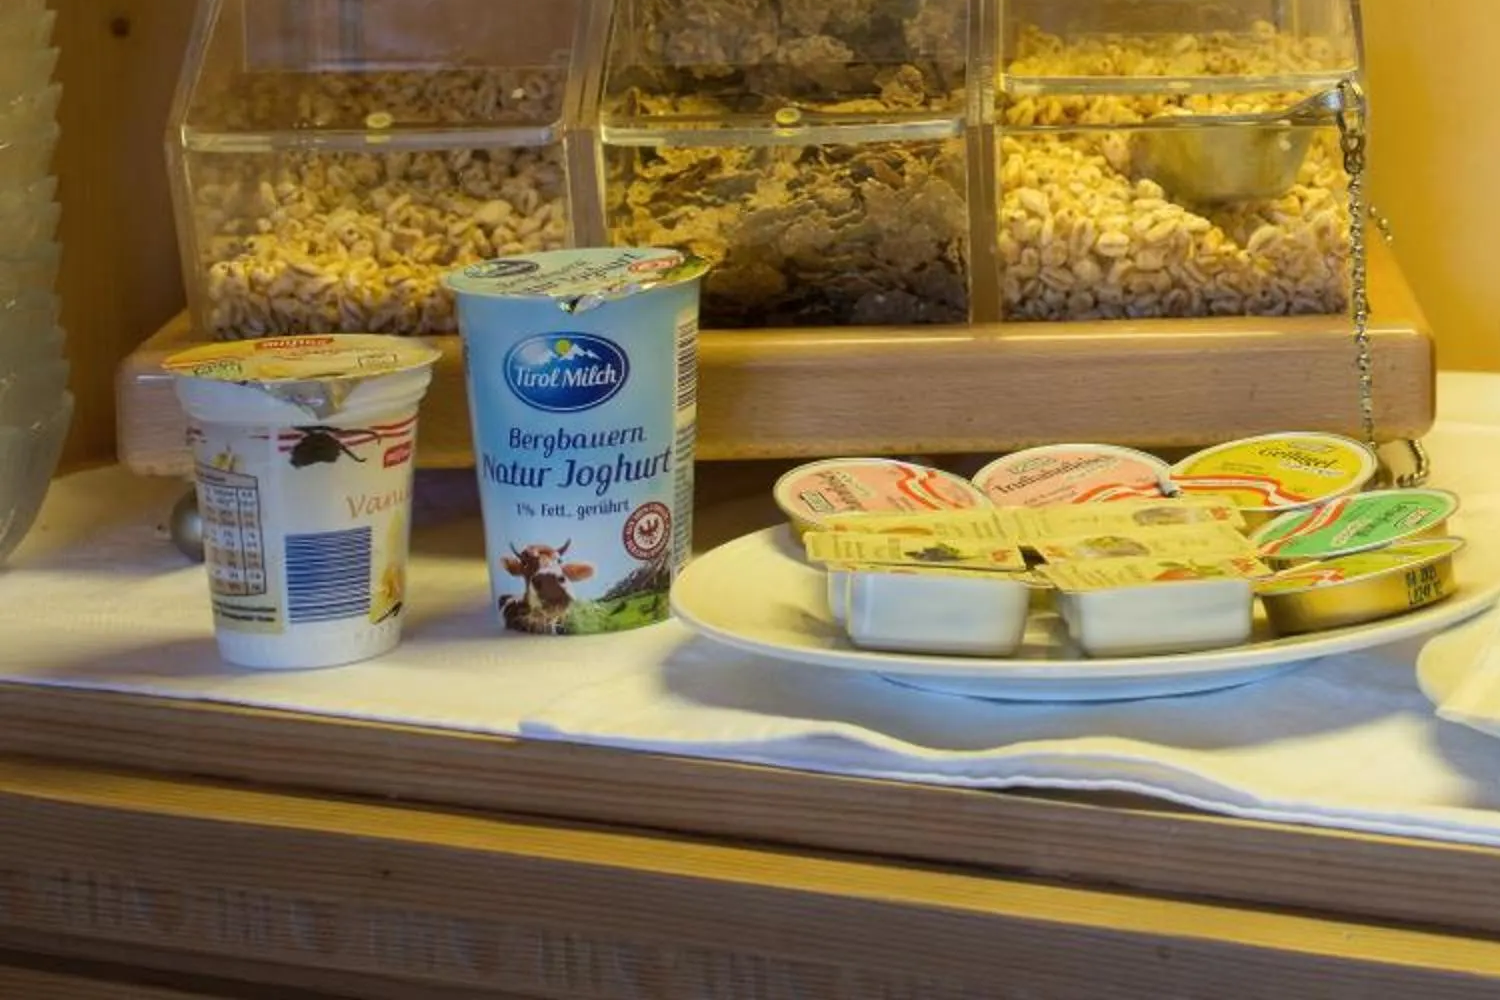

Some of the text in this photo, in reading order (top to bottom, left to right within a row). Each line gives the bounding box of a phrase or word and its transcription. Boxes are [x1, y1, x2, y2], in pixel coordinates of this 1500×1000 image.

[515, 363, 617, 387] Tirol Milch
[509, 426, 645, 458] Bergbauern
[483, 446, 672, 496] Natur Joghurt
[517, 503, 535, 517] 1%
[575, 500, 630, 520] gerührt
